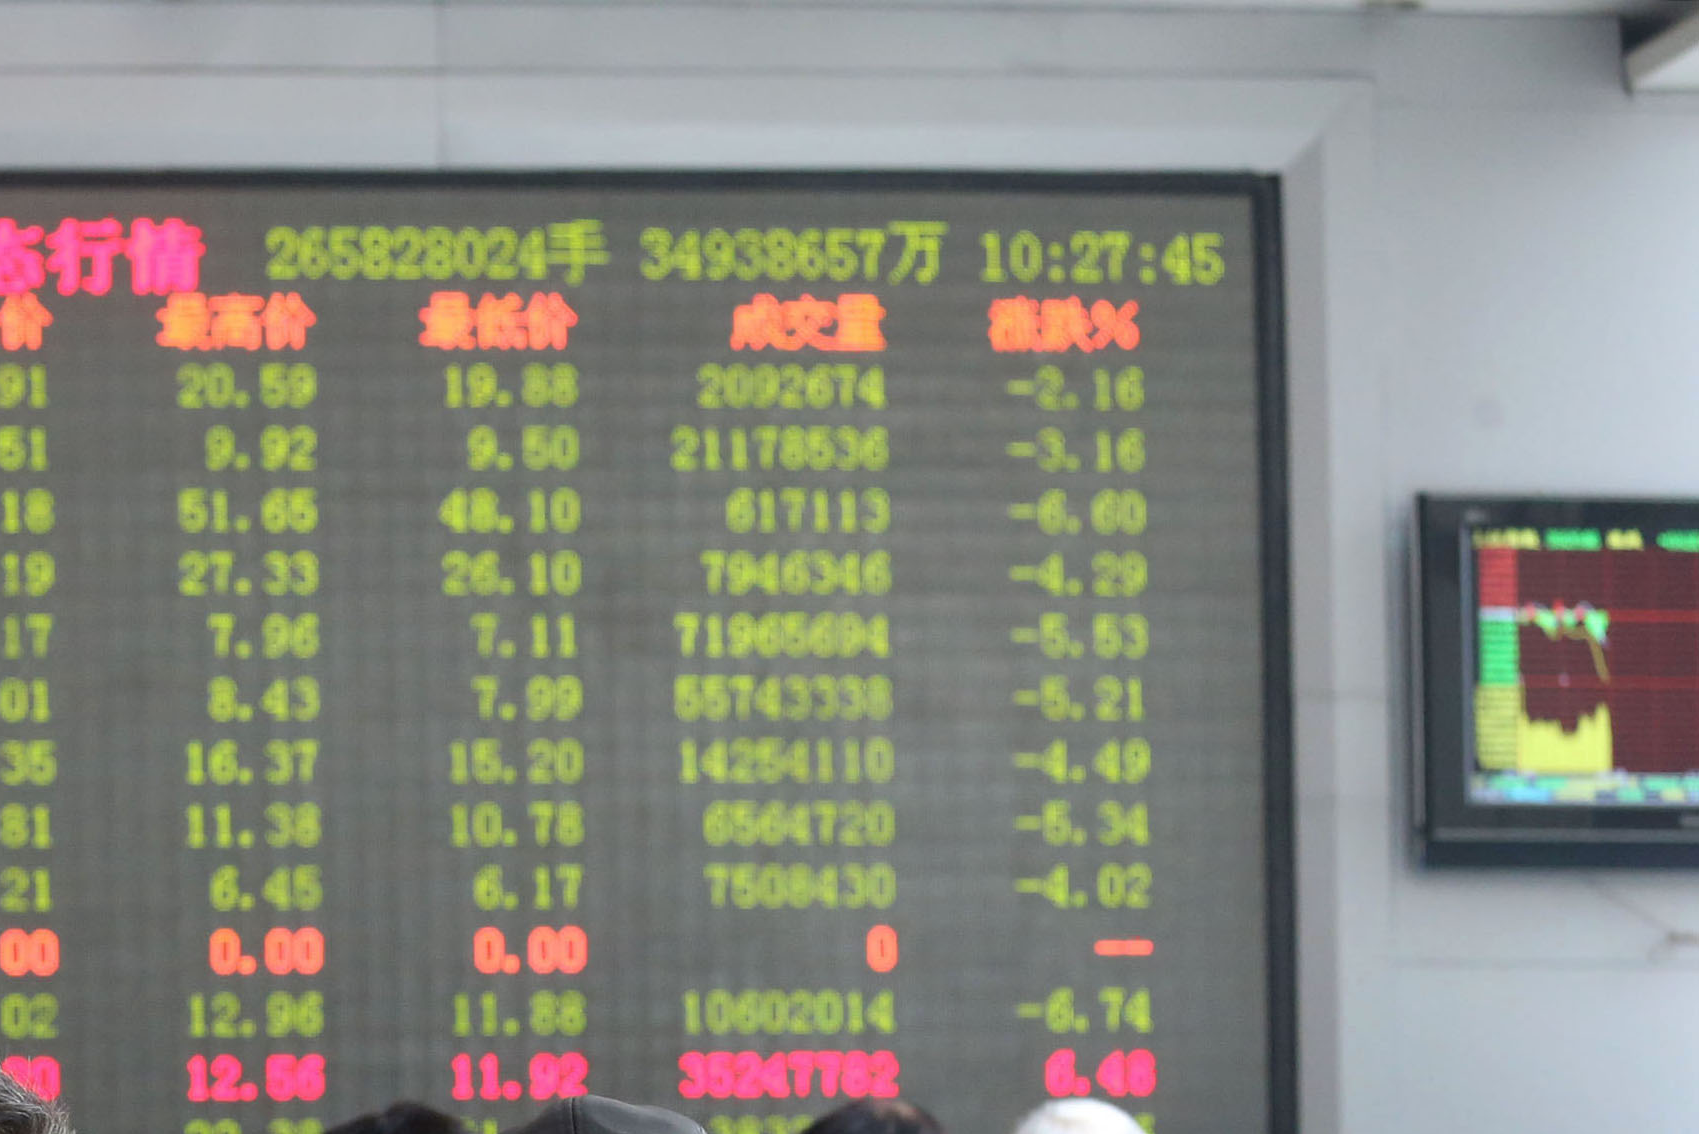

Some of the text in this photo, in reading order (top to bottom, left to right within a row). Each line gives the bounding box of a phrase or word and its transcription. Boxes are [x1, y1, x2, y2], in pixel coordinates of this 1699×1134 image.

[265, 219, 611, 287] 265828024手
[638, 220, 949, 286] 34938657万
[979, 230, 1226, 285] 10:27:45
[155, 292, 317, 351] 最高价
[418, 291, 579, 350] 最低价
[730, 293, 886, 352] 成交量
[178, 363, 317, 408] 20.59
[446, 363, 578, 408] 19.88
[207, 426, 316, 471] 9.92
[468, 426, 579, 470] 9.50
[179, 488, 318, 532] 51.65
[440, 488, 580, 532] 48.10
[726, 488, 890, 532] 617113
[180, 551, 319, 596] 27.33
[443, 551, 582, 595] 26.10
[208, 613, 319, 658] 7.96
[472, 613, 576, 658] 7.11
[209, 677, 320, 721] 8.43
[473, 676, 583, 720] 7.99
[187, 740, 318, 784] 16.37
[451, 739, 584, 784] 15.20
[188, 803, 321, 848] 11.38
[452, 801, 584, 847] 10.78
[210, 865, 322, 910] 6.45
[474, 865, 582, 910] 6.17
[209, 926, 325, 976] 0.00
[473, 925, 589, 974] 0.00
[866, 924, 899, 973] 0
[190, 992, 324, 1037] 12.96
[454, 991, 586, 1036] 11.88
[685, 990, 895, 1034] 10602014
[186, 1053, 326, 1102] 12.56
[451, 1052, 589, 1101] 11.92
